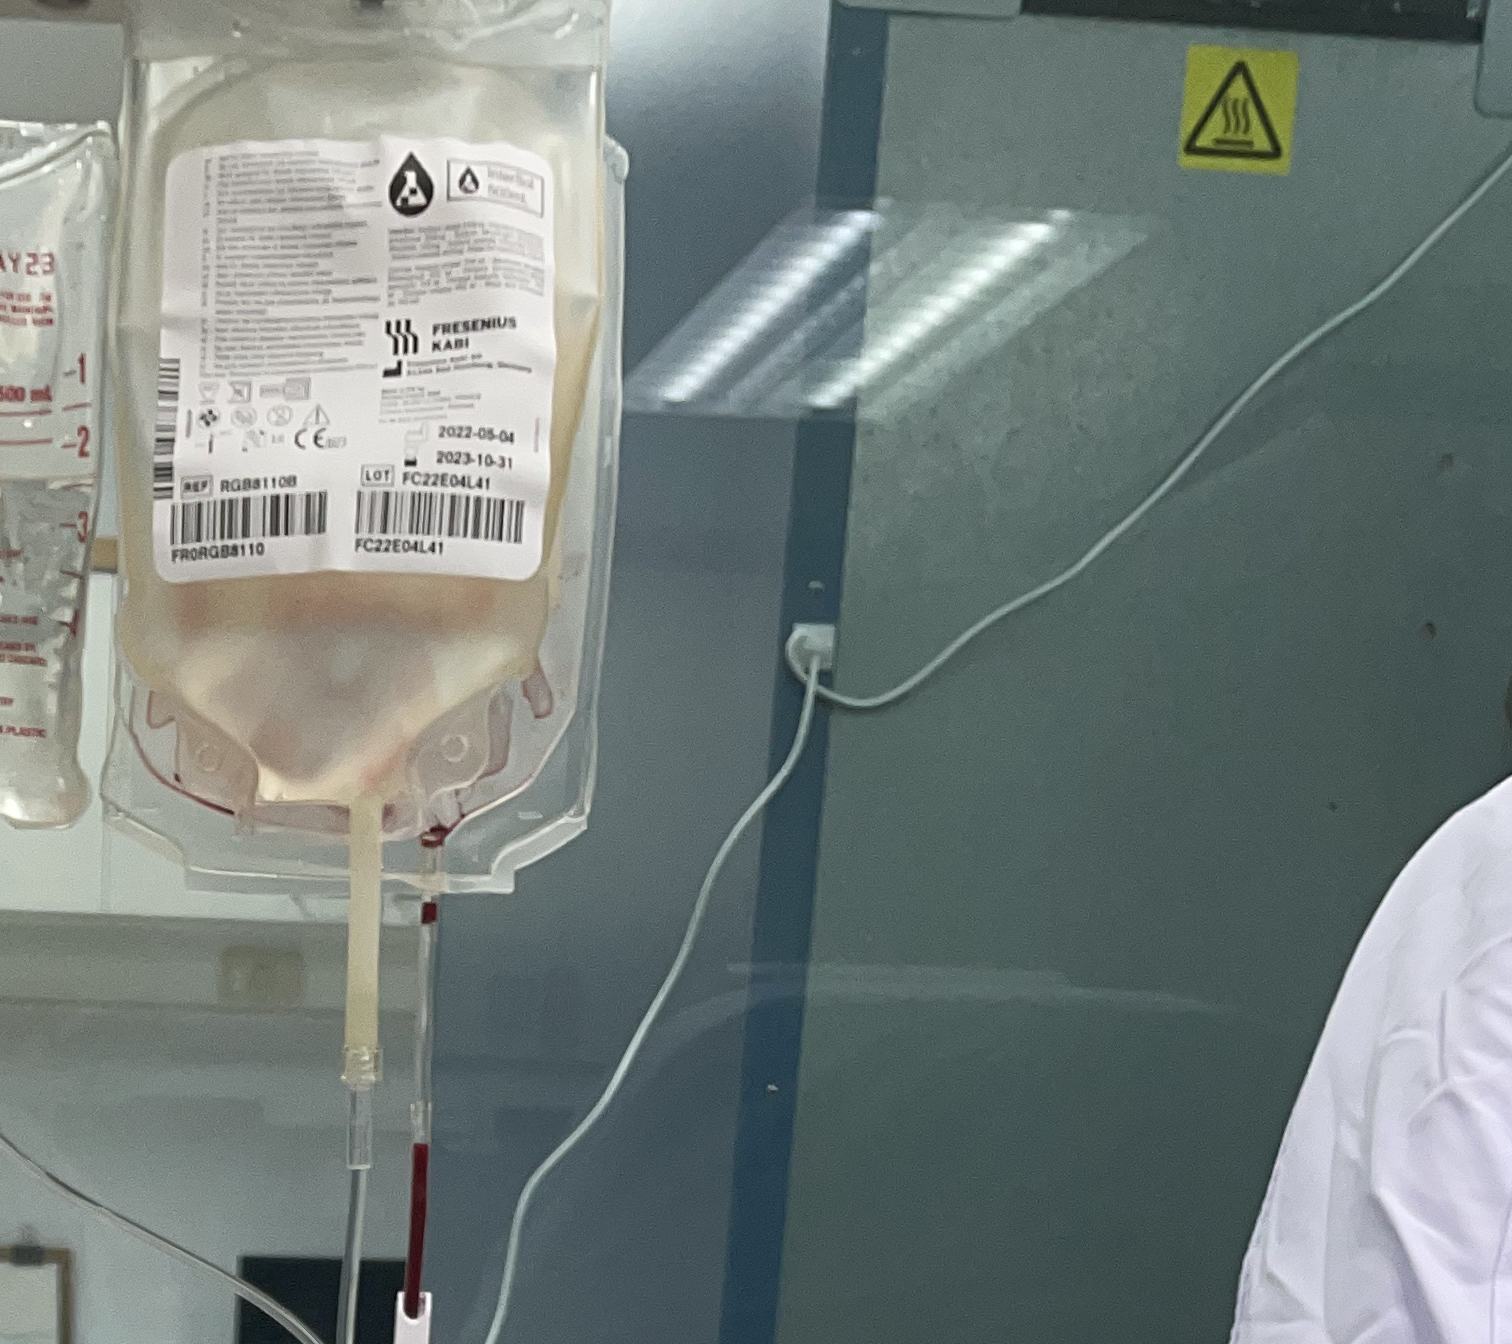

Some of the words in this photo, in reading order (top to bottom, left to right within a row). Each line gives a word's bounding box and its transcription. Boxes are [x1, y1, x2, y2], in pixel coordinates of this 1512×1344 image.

[26, 252, 55, 275] 23
[432, 316, 517, 337] FRESENIUS
[432, 338, 470, 351] KABI
[436, 450, 512, 470] 2023-10-31
[365, 469, 390, 482] LOT
[402, 470, 490, 489] FC22E04L41
[354, 537, 444, 555] FC22E04L41
